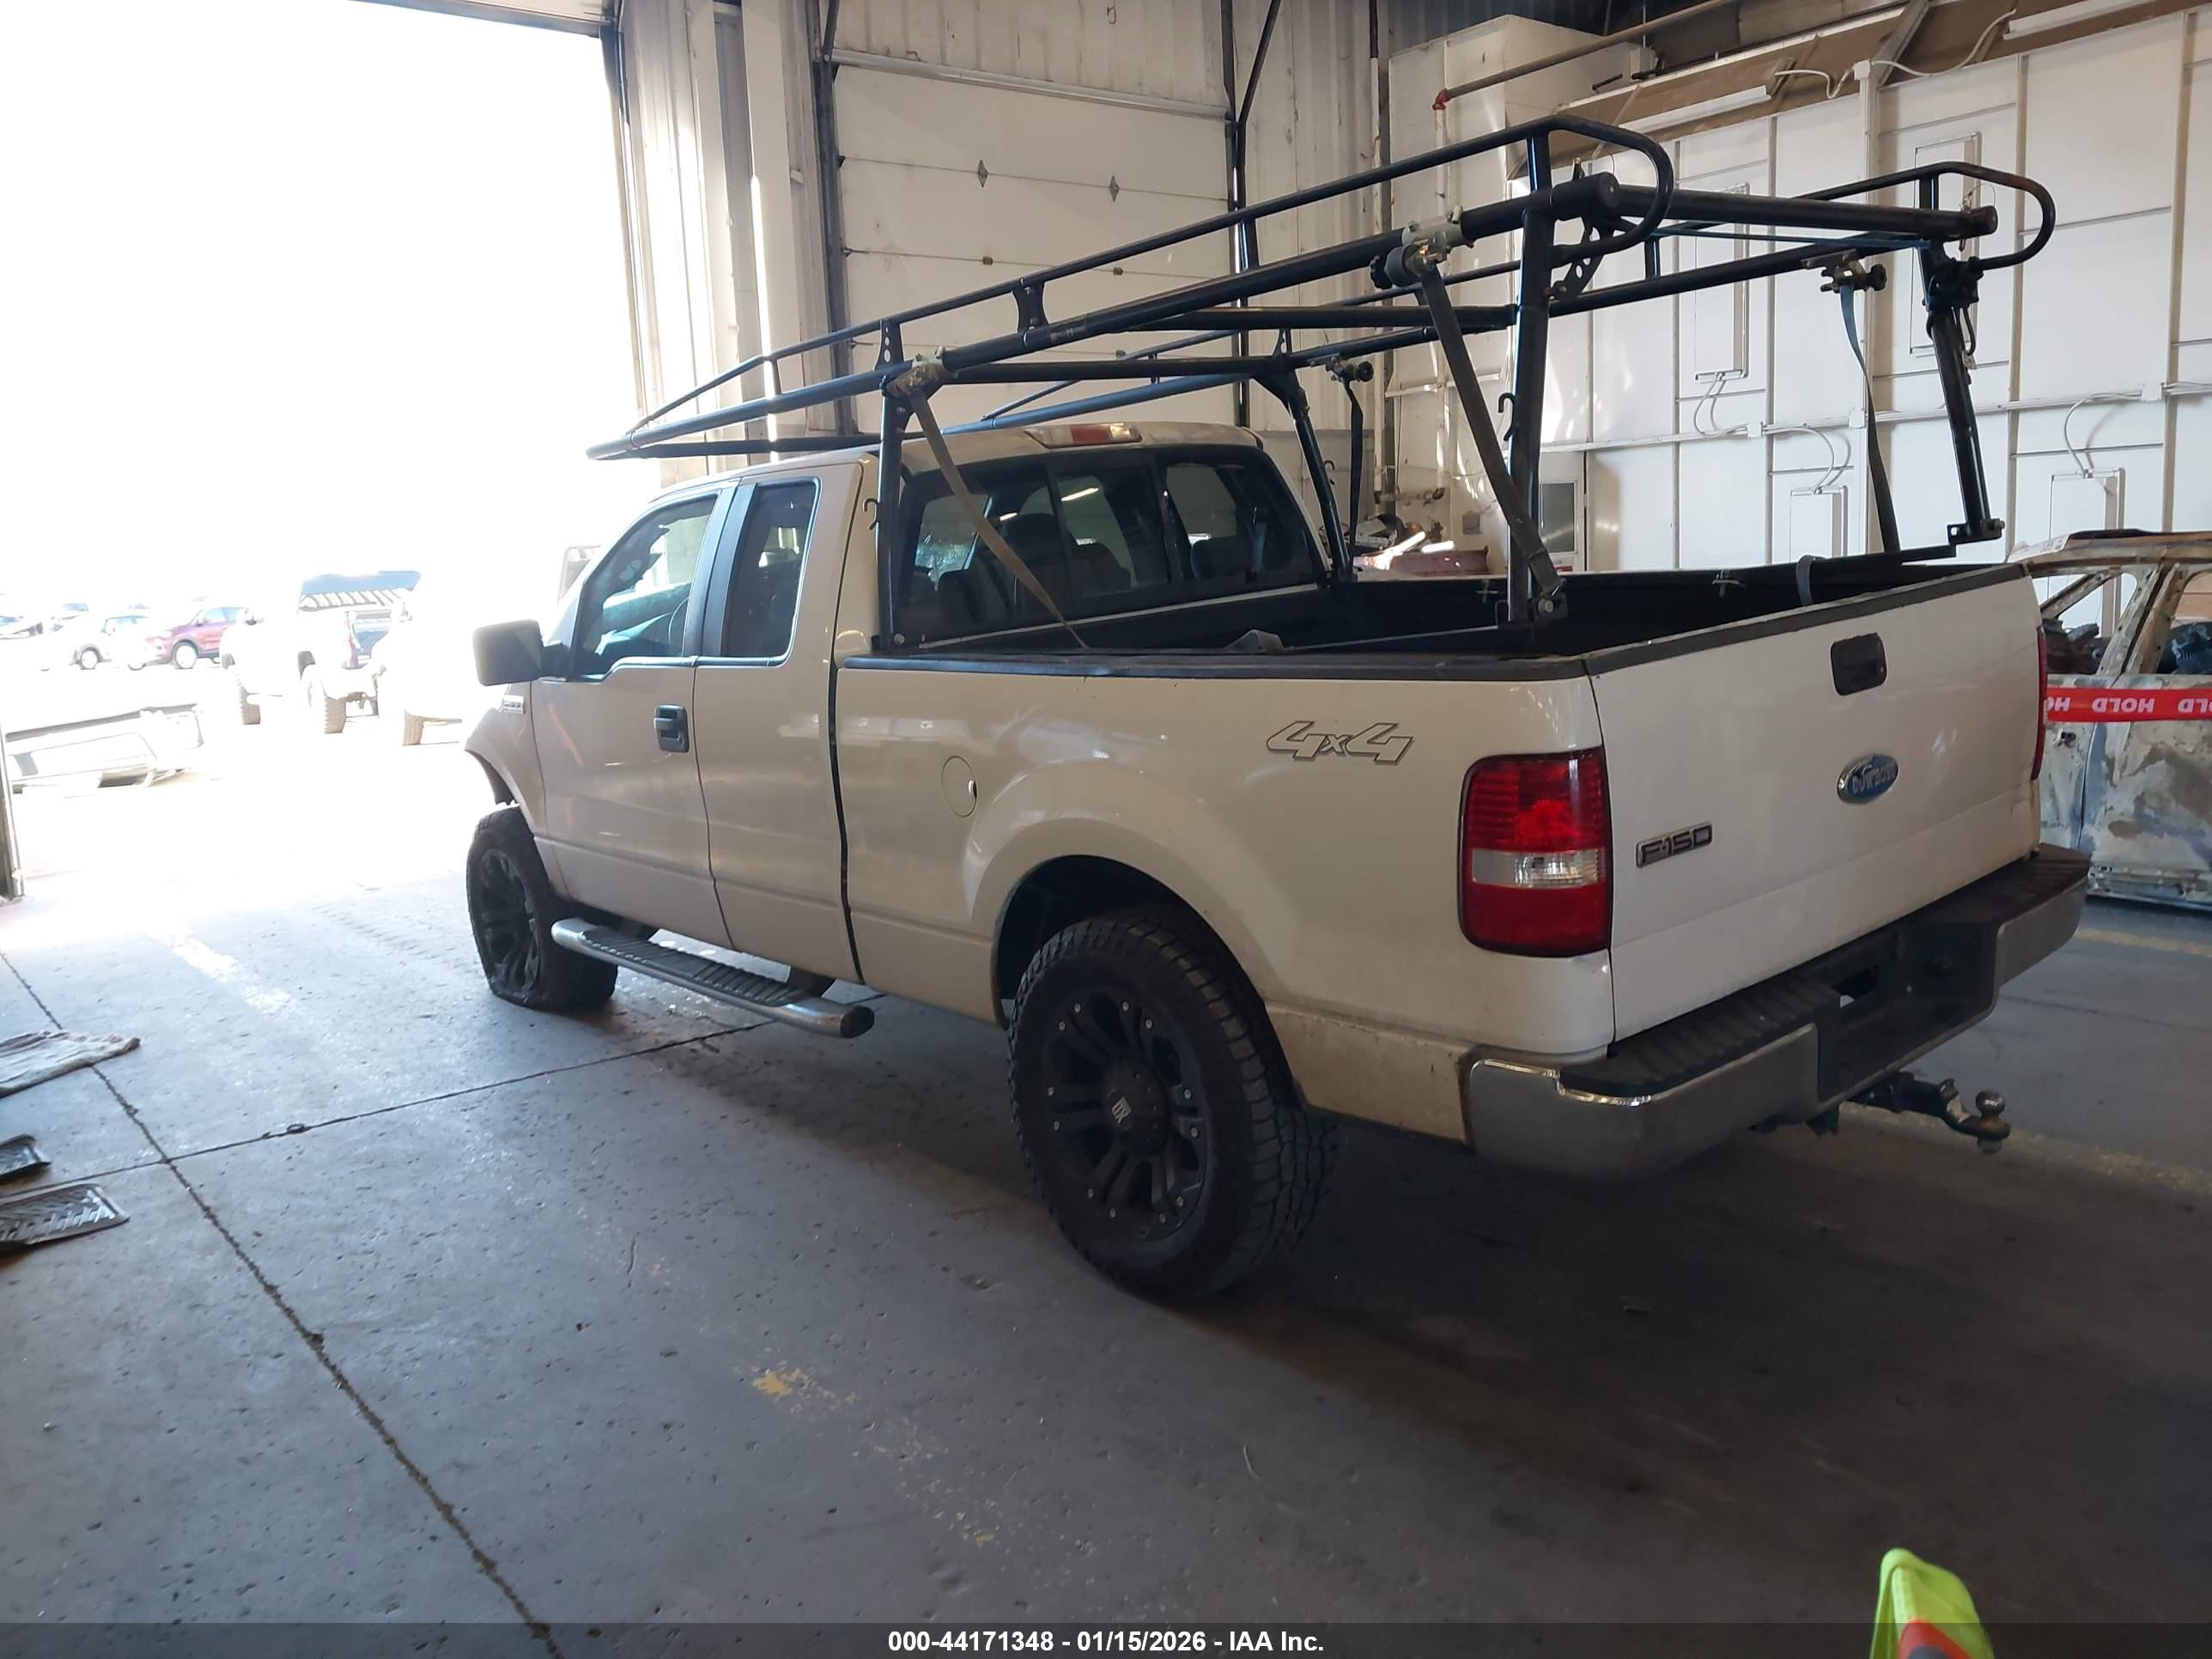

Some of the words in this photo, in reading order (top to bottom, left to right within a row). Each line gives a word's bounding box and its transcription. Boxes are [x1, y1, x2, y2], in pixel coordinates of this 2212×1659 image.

[2092, 697, 2156, 713] HOLD
[2178, 698, 2212, 713] LD
[1267, 720, 1414, 765] 4x4
